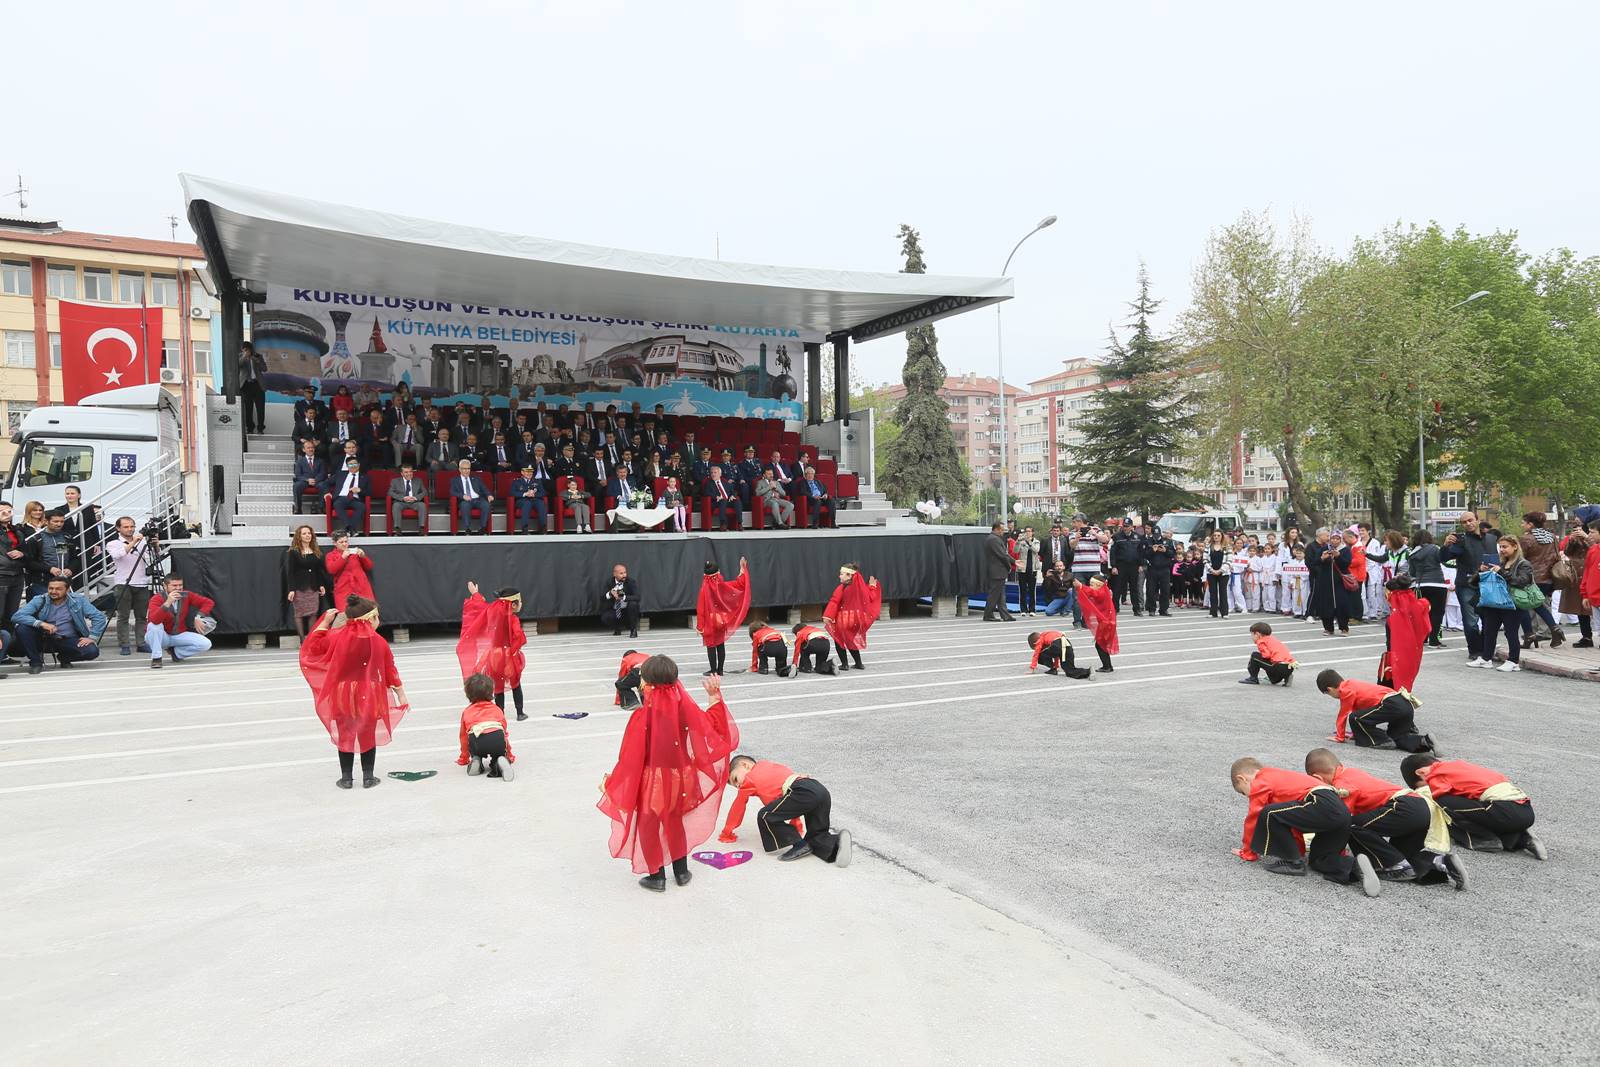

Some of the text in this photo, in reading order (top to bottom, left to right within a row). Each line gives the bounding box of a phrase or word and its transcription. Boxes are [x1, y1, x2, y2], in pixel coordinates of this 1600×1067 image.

[293, 288, 452, 312] KURULUŞUN
[461, 304, 490, 315] VE
[387, 317, 576, 346] KÜTAHYA BELEDİYESİ
